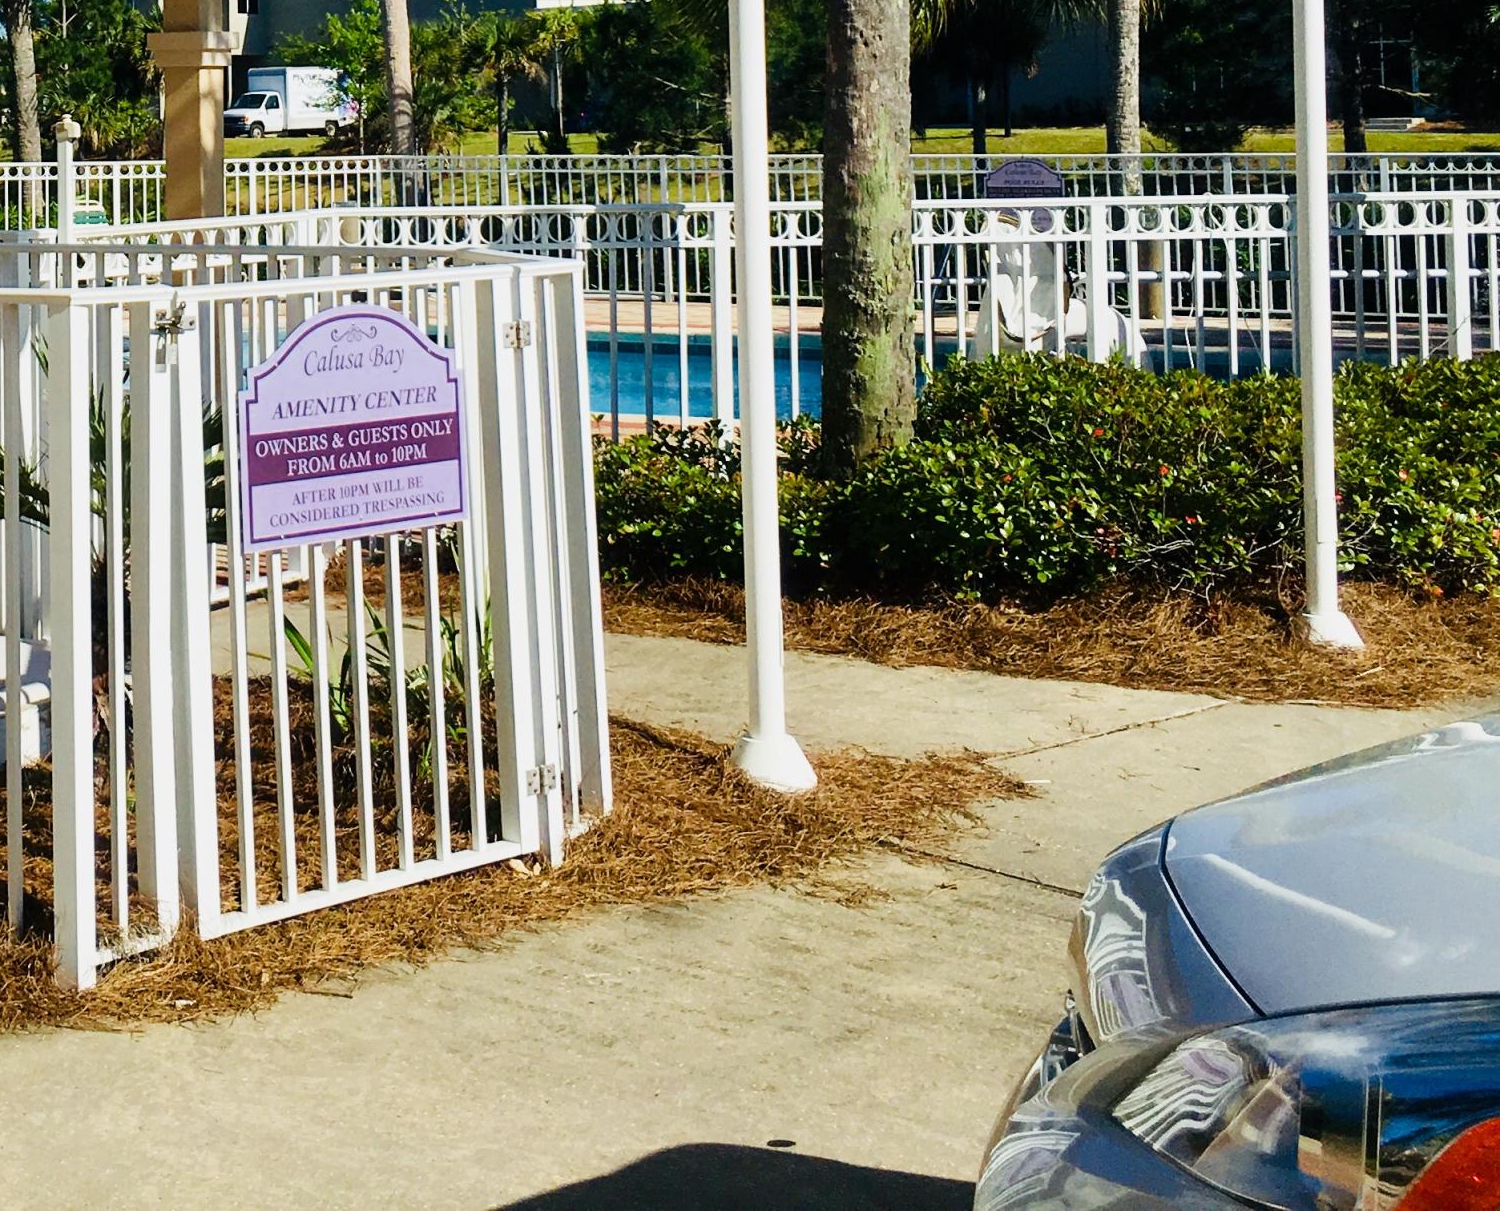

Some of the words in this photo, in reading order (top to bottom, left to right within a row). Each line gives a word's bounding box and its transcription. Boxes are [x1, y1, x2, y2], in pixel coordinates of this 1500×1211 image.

[304, 345, 363, 376] Calusa
[369, 344, 405, 373] Bay
[272, 394, 361, 420] AMENITY
[365, 386, 437, 409] CENTER
[255, 433, 327, 458] OWNERS
[332, 433, 344, 448] &
[348, 424, 408, 447] GUESTS
[410, 418, 453, 438] ONLY
[287, 455, 336, 476] FROM
[339, 451, 371, 470] 6AM
[375, 452, 388, 465] to
[391, 443, 427, 462] 10PM
[292, 489, 336, 506] AFTER
[340, 483, 369, 500] 10PM
[371, 478, 405, 494] WILL
[407, 476, 424, 489] BE
[270, 504, 360, 528] CONSIDERED
[363, 491, 445, 515] TRESPASSING
